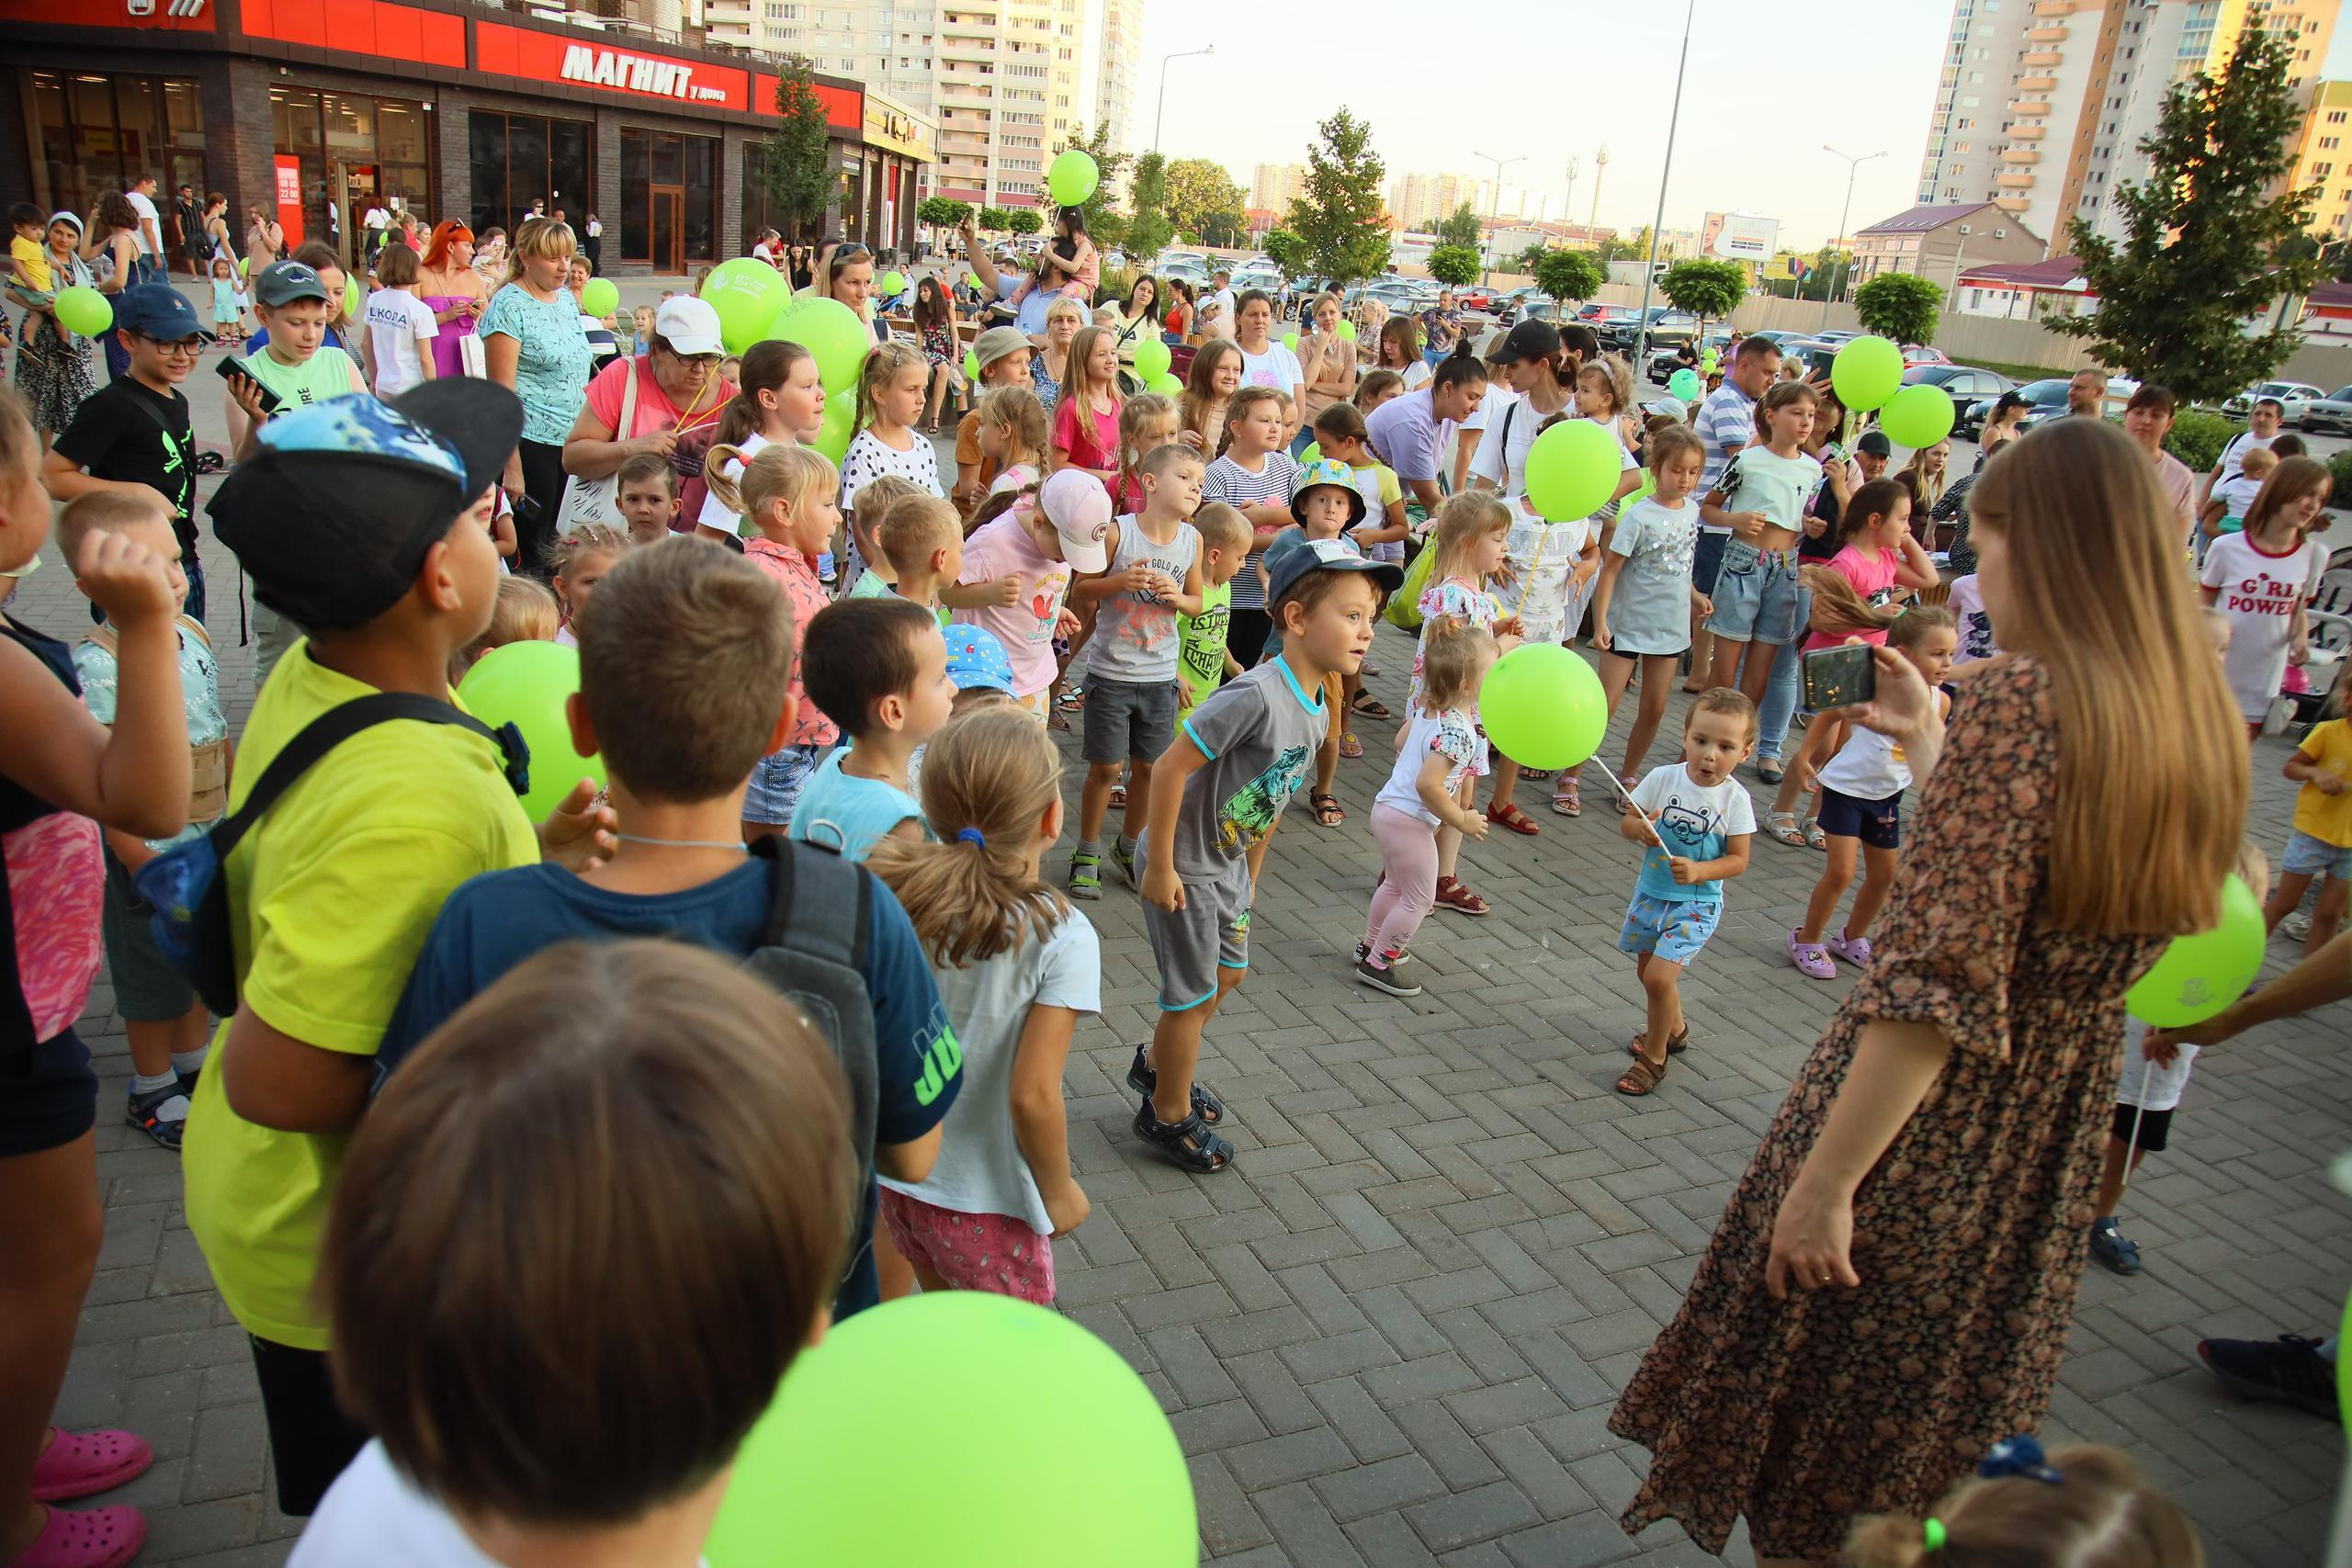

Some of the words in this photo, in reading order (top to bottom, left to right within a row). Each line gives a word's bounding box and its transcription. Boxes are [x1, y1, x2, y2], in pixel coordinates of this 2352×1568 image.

[560, 45, 693, 98] МАГНИТ
[698, 87, 726, 102] дома
[1151, 558, 1171, 571] GOLD
